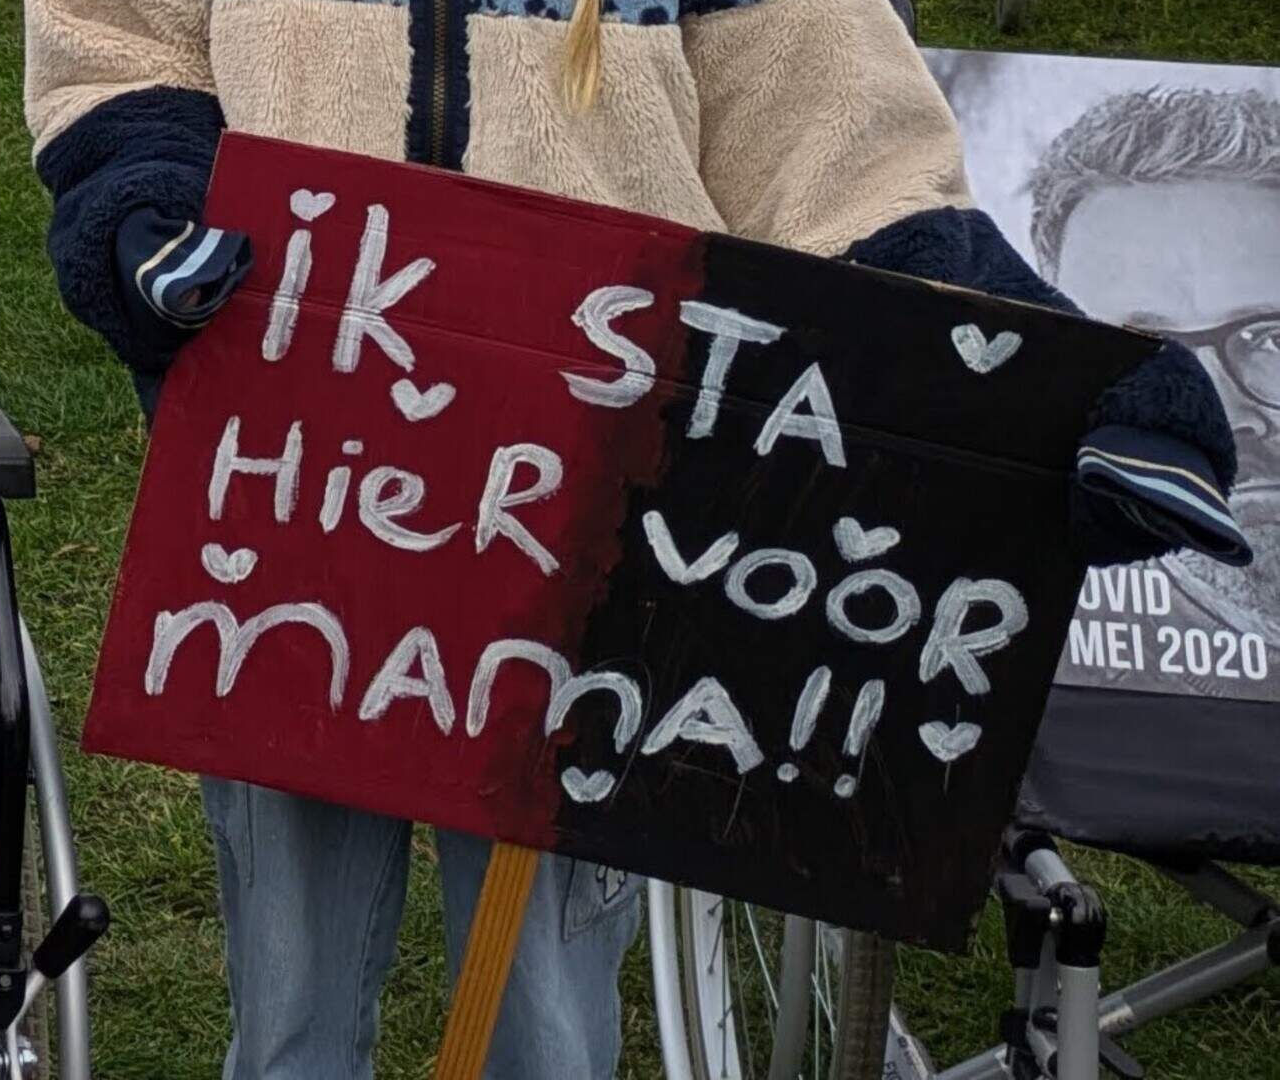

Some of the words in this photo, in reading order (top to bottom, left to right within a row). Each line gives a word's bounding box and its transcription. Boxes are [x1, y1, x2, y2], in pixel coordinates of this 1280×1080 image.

[560, 285, 848, 469] STA
[1067, 618, 1145, 671] MEI
[1156, 625, 1268, 681] 2020
